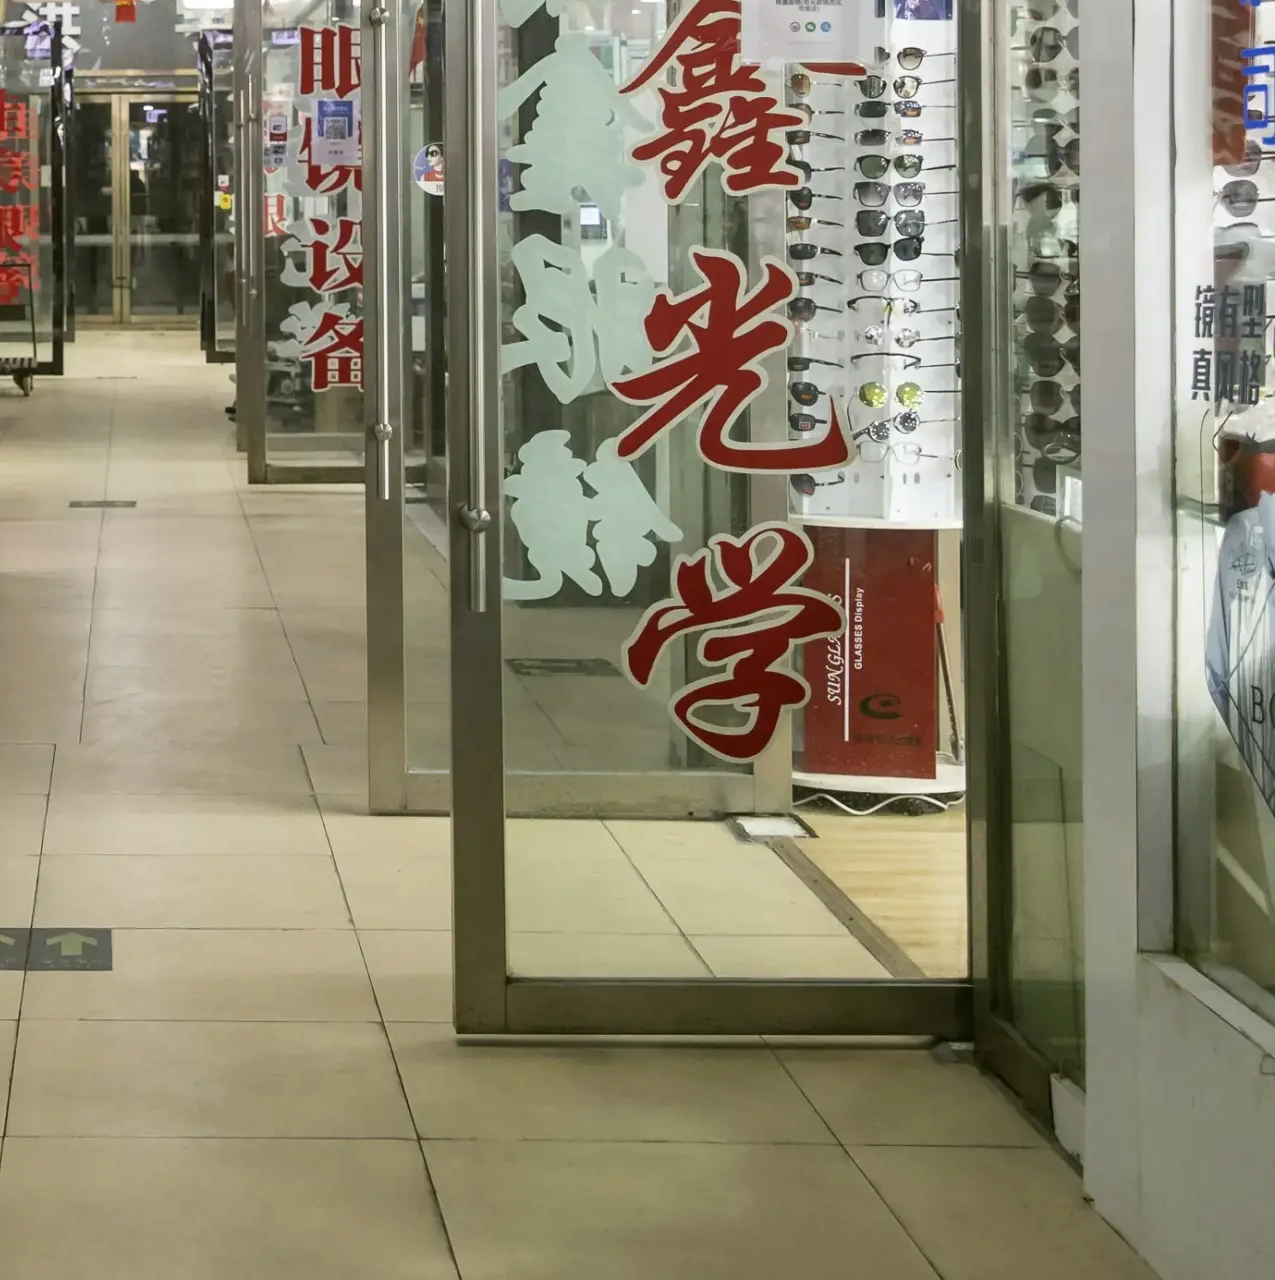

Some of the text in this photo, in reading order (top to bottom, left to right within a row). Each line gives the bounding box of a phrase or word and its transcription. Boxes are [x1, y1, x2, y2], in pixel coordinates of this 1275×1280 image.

[1194, 283, 1265, 338] 镜有型
[1191, 348, 1261, 405] 真风格
[853, 587, 865, 670] GLASSES Display
